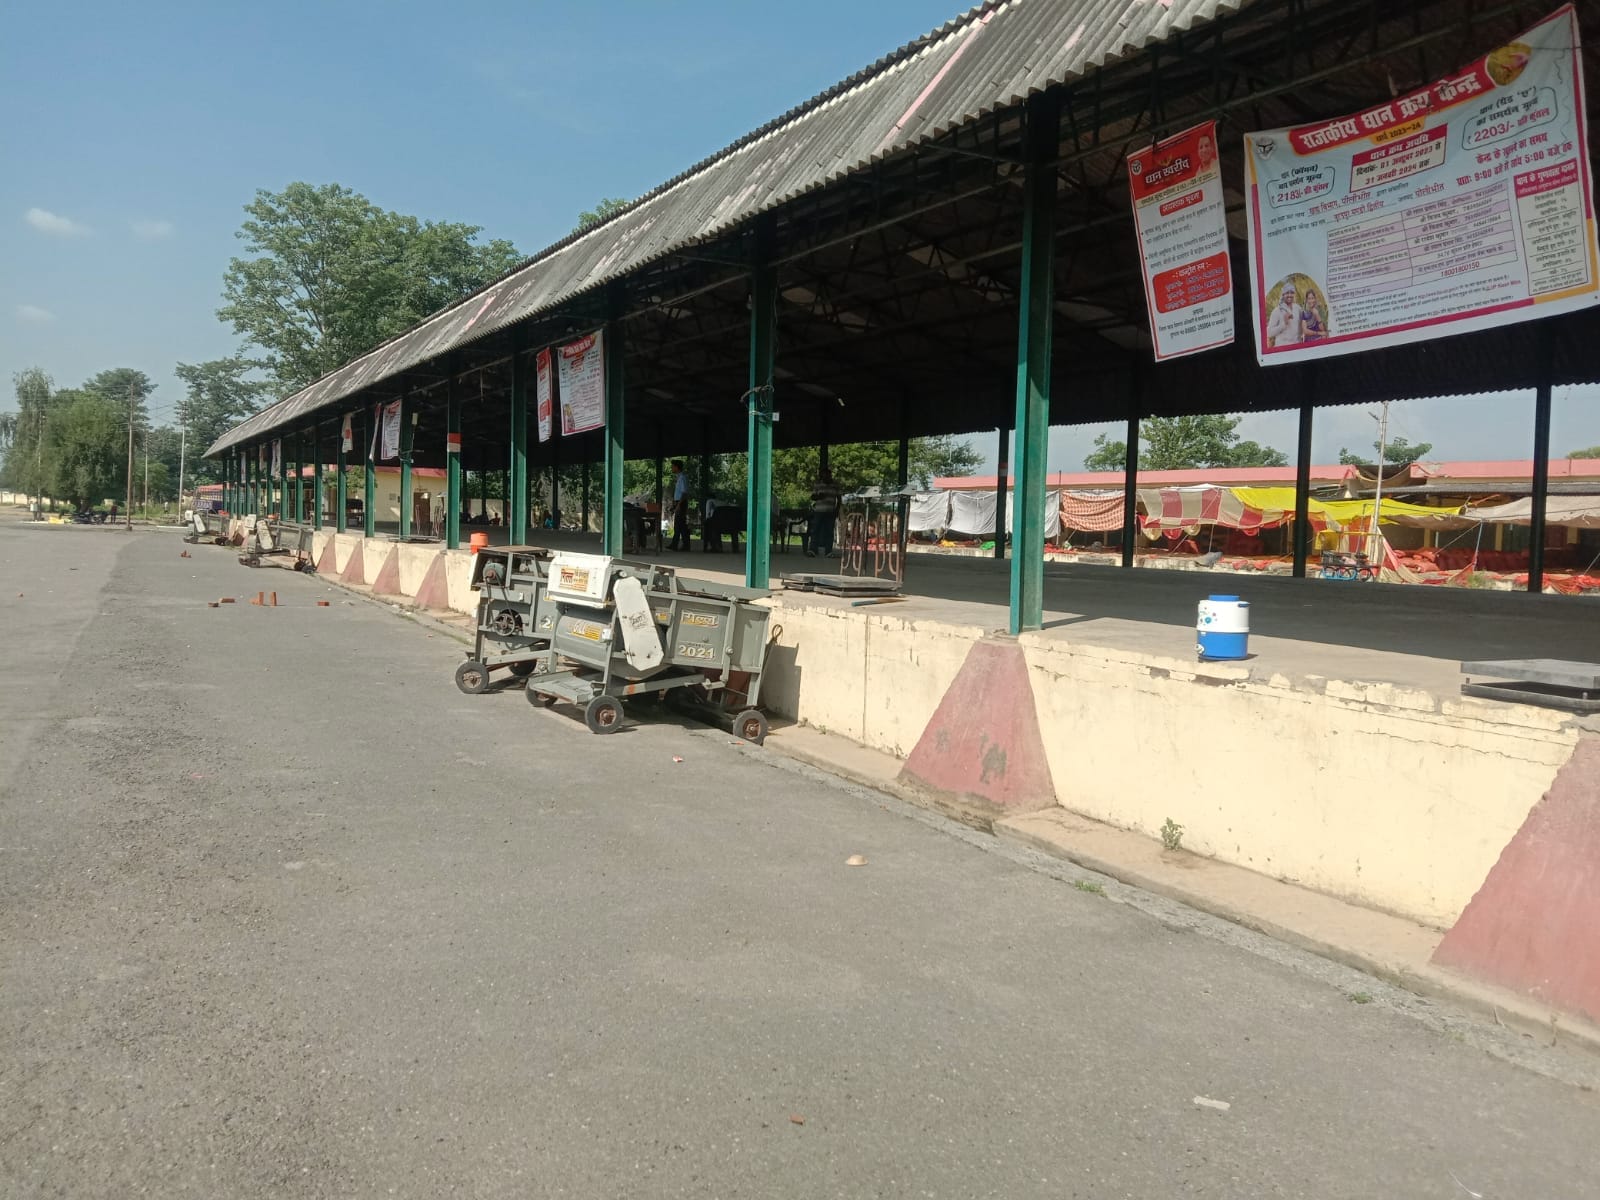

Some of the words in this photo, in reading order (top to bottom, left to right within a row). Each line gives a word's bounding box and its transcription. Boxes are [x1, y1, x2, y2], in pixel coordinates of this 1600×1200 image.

[1299, 117, 1361, 149] राजकीय
[1361, 105, 1396, 130] धान
[1397, 91, 1433, 118] क्रय
[1434, 72, 1482, 101] केन्द्र
[1474, 121, 1515, 142] 2203/-
[1145, 170, 1161, 184] धान
[1162, 158, 1191, 176] खरीद
[679, 644, 714, 659] 2021
